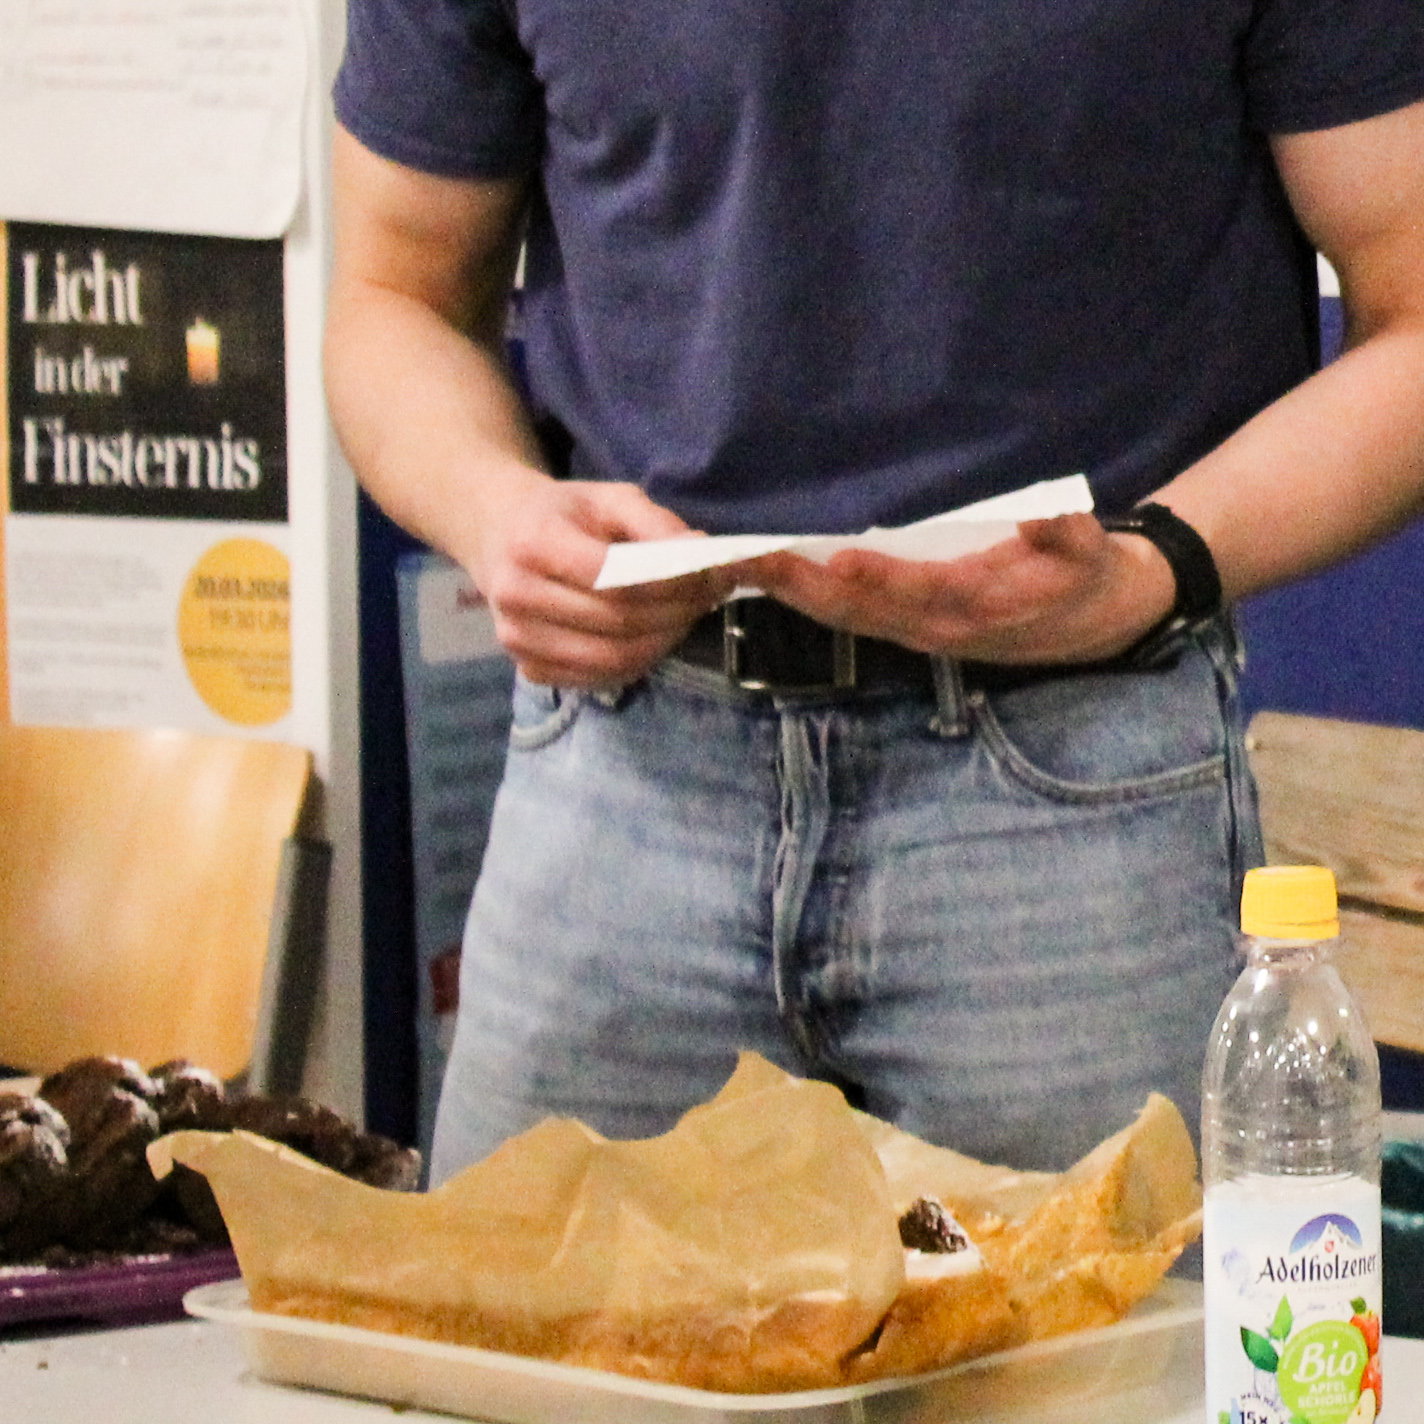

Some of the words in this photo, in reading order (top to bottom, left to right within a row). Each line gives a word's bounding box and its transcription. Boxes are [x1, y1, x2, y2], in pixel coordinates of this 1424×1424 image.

[23, 248, 144, 326] Licht
[34, 346, 68, 394] in
[70, 345, 129, 396] der
[23, 416, 261, 490] Finsternis
[1255, 1254, 1377, 1285] Adelholzener
[1292, 1340, 1358, 1383] Bio
